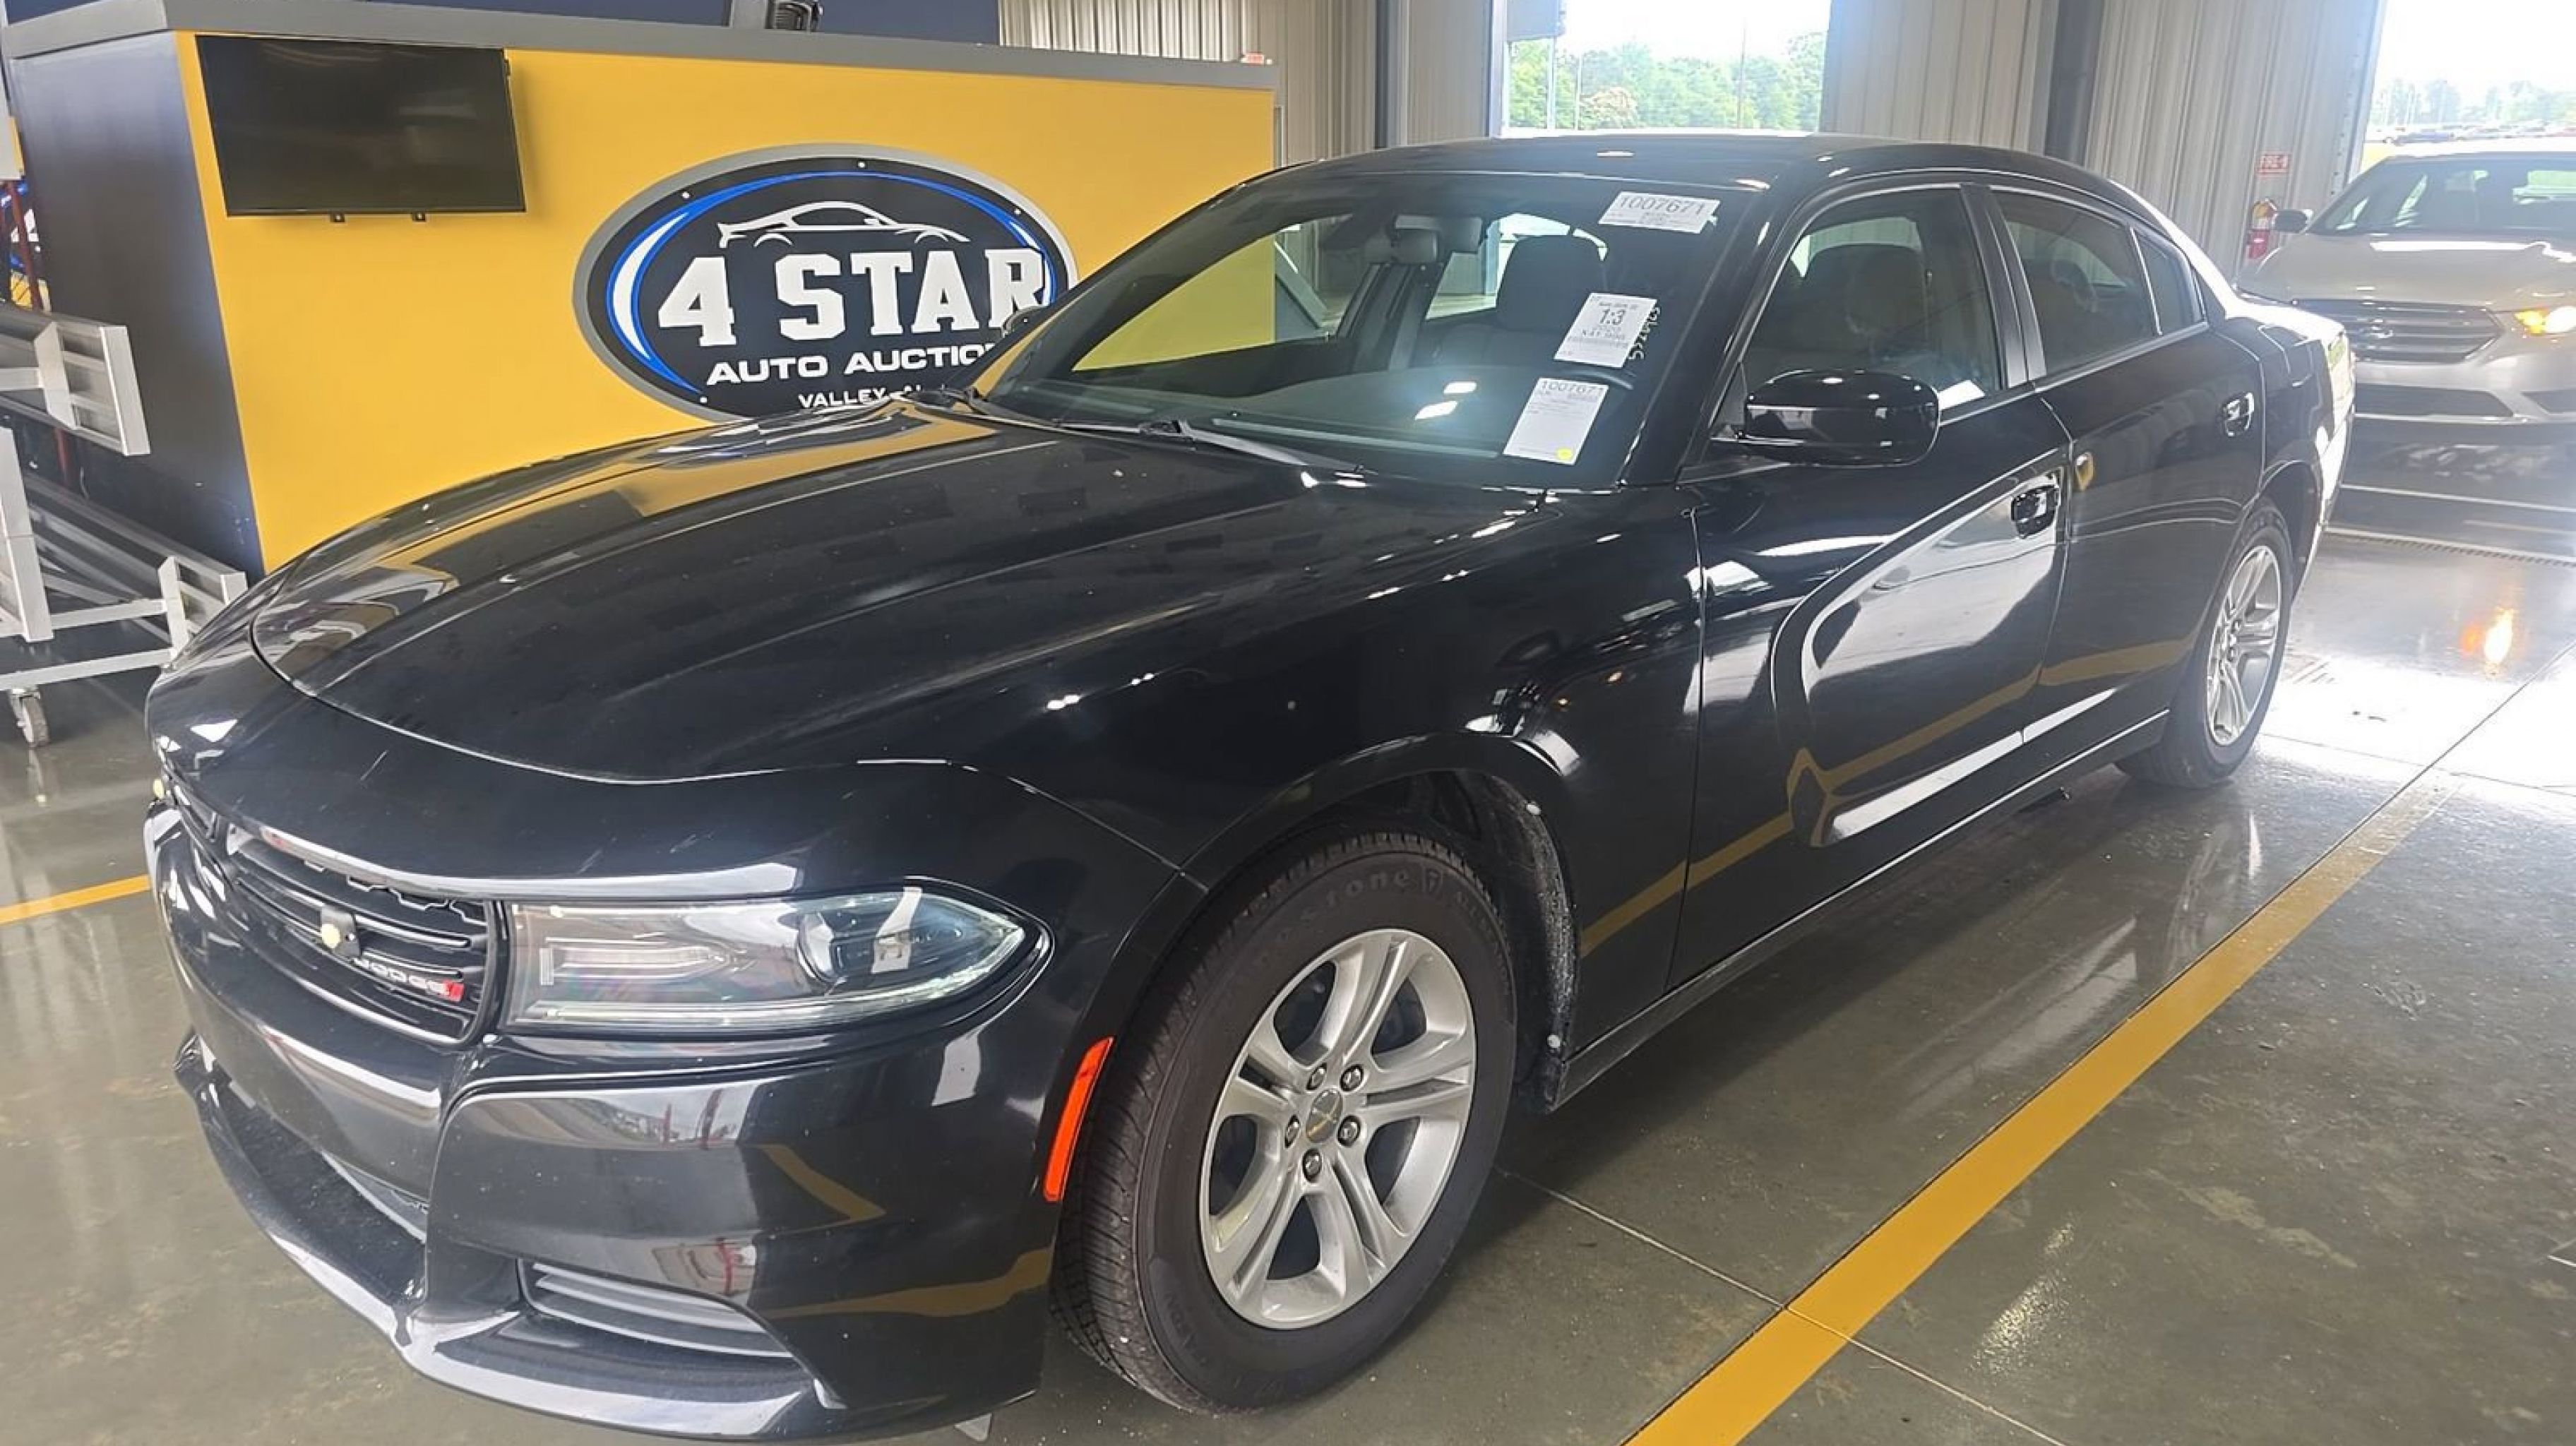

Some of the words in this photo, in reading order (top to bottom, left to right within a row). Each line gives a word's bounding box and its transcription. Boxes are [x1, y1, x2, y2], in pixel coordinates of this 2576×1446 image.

[1621, 196, 1705, 215] 1007671
[657, 256, 737, 346] 4
[776, 249, 1043, 340] STAR
[707, 354, 829, 386] AUTO
[844, 342, 996, 375] AUCTIO
